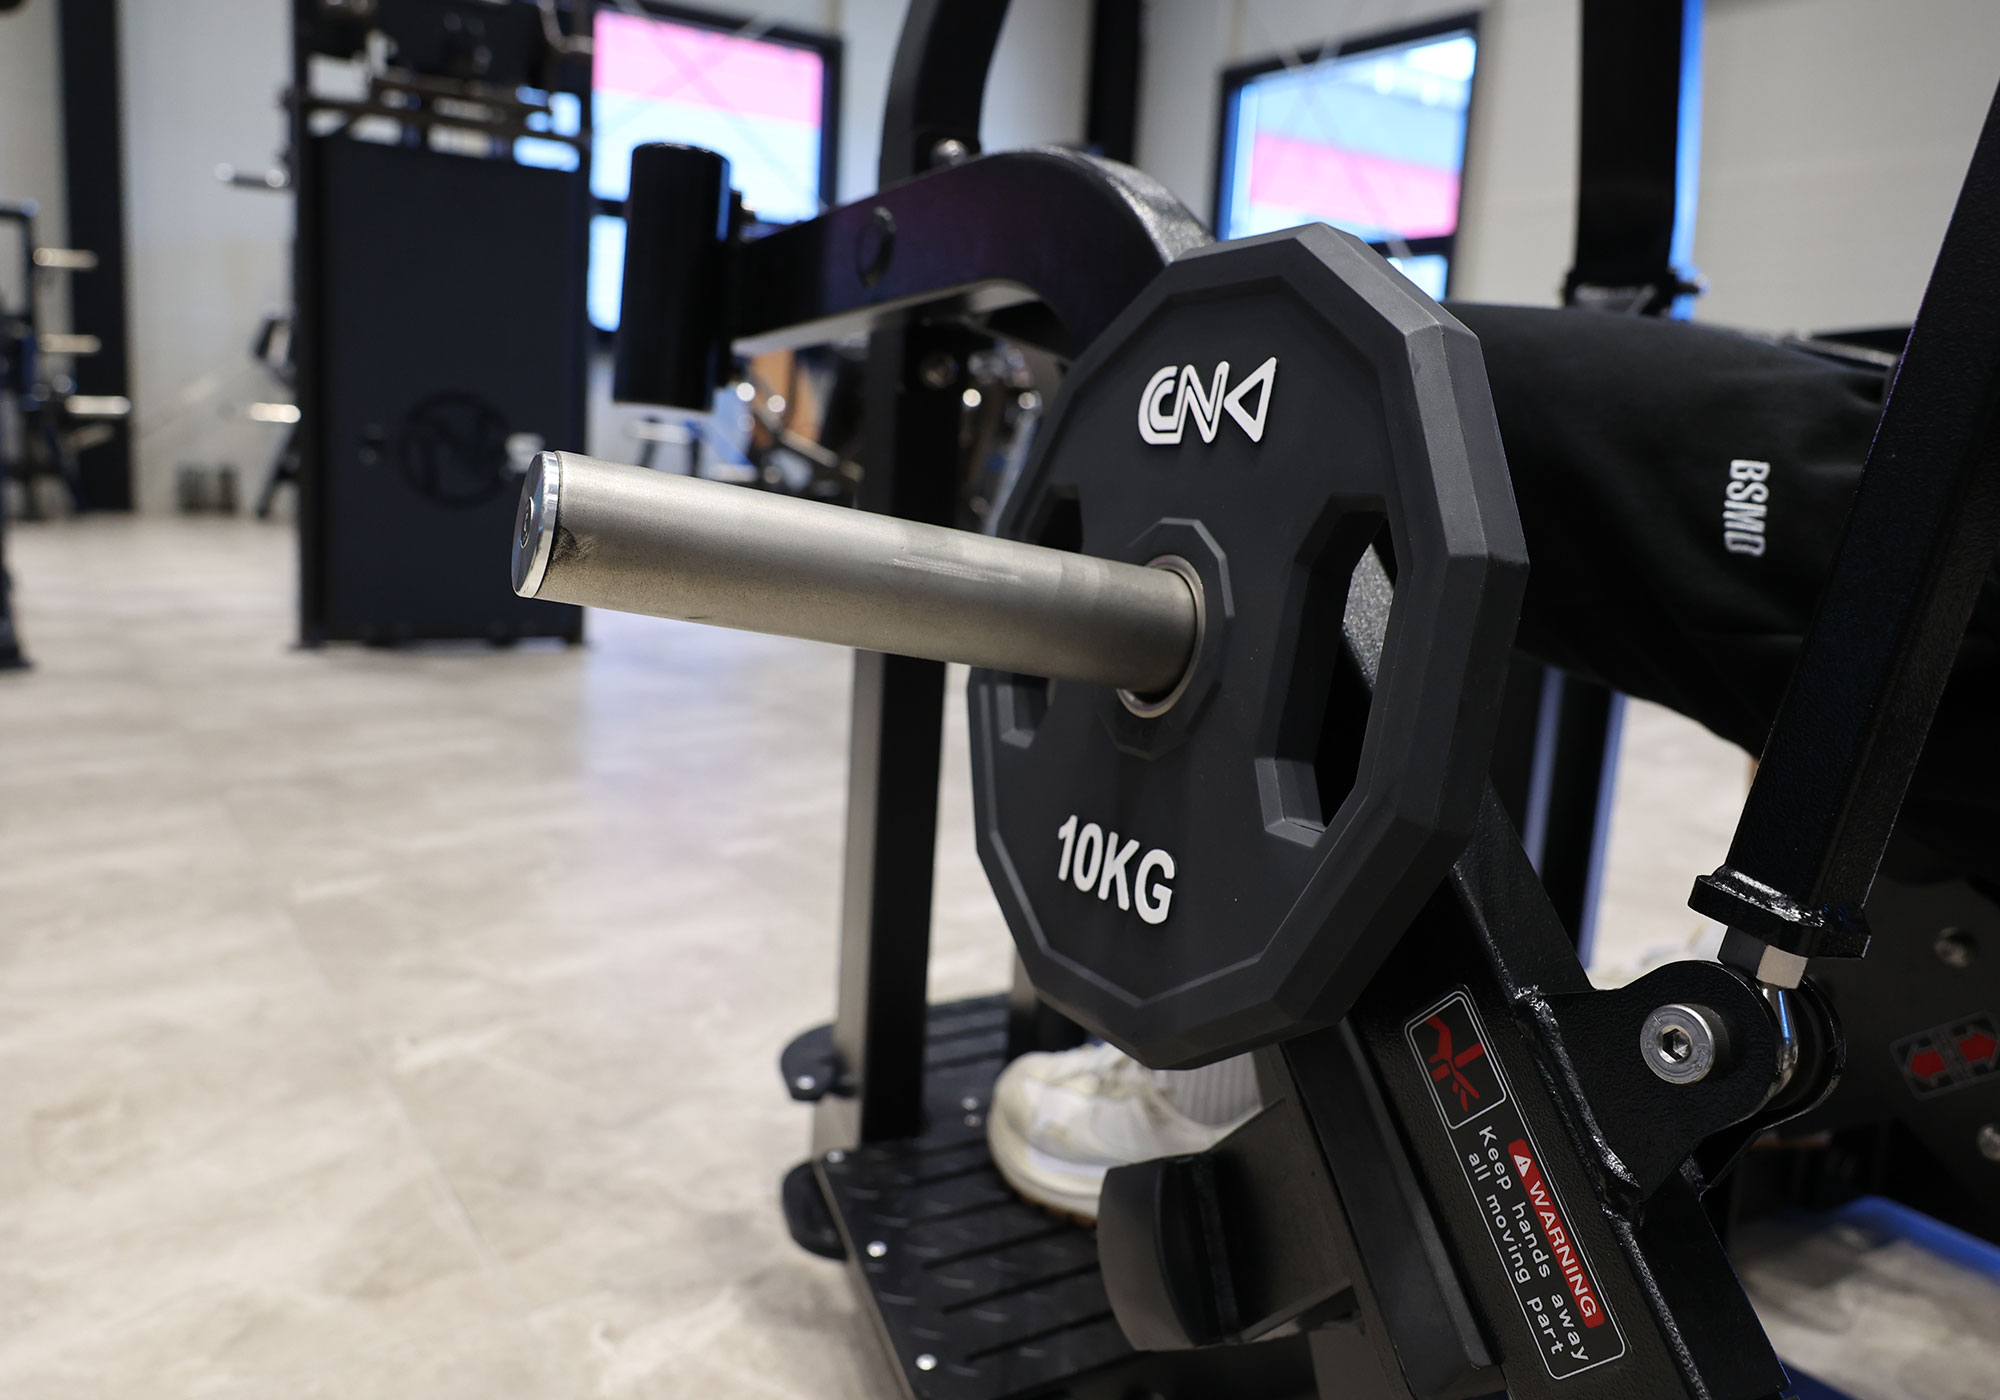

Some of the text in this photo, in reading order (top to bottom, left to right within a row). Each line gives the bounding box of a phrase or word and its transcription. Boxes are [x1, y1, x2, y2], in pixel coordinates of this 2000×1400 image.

[1722, 459, 1771, 556] BSMD
[1057, 814, 1176, 925] 10KG
[1468, 1152, 1564, 1355] all moving part
[1478, 1125, 1589, 1362] Keep hands away
[1529, 1180, 1597, 1318] WARNING
